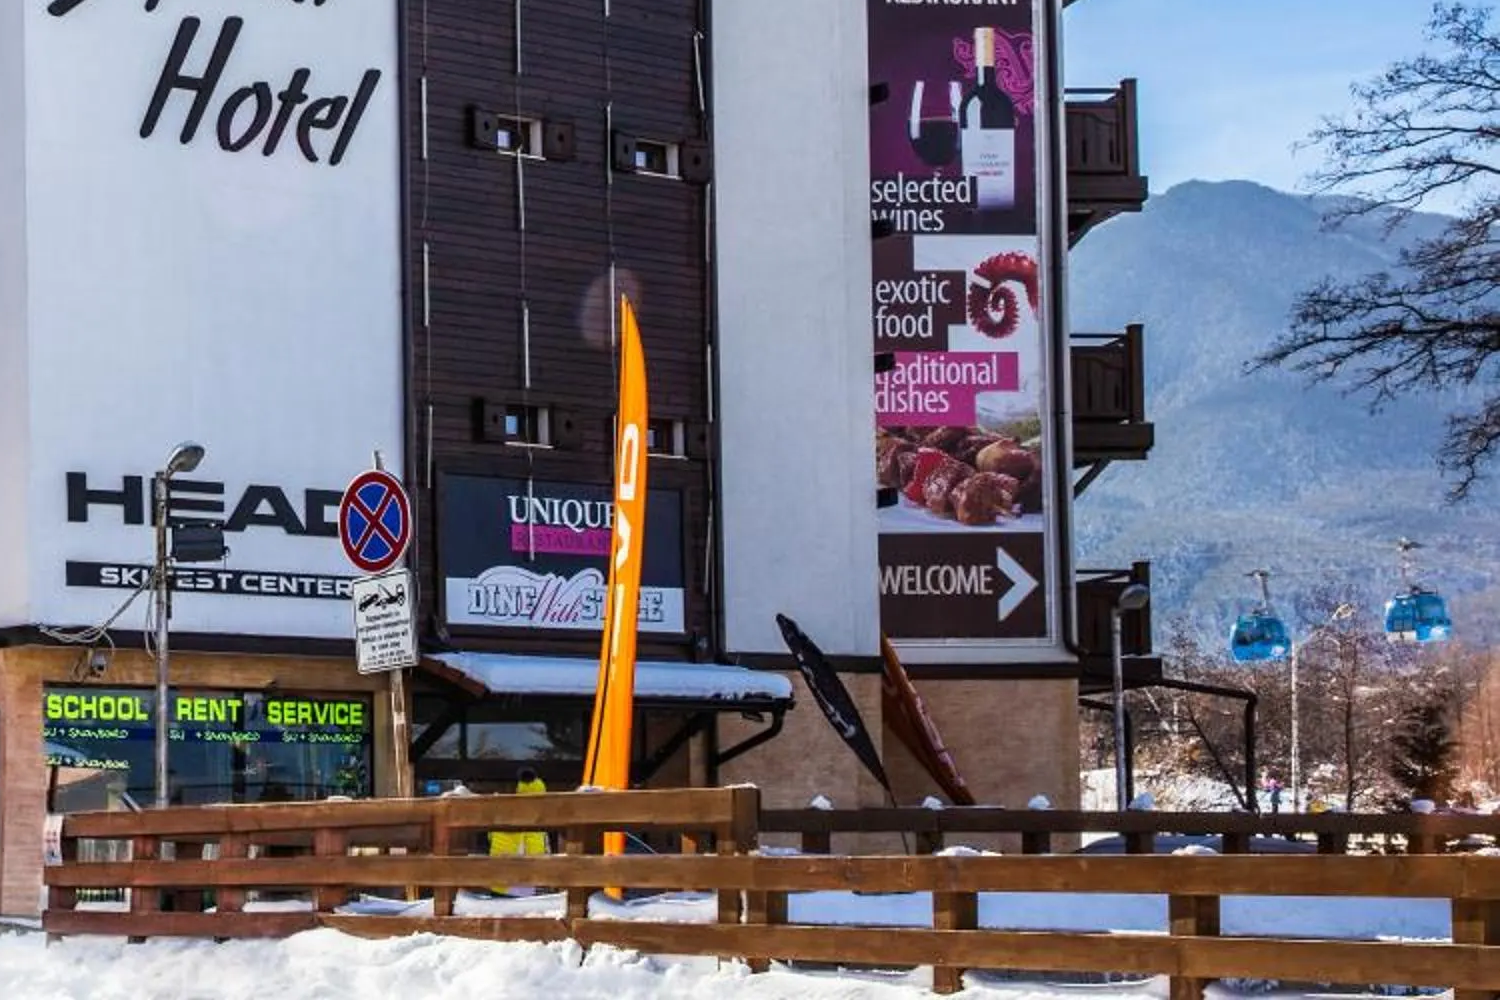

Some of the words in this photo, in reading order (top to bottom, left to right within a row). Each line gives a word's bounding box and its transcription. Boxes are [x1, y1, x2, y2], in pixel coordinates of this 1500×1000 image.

[140, 16, 381, 165] Hotel
[871, 172, 971, 203] selected
[875, 274, 950, 304] exotic
[875, 306, 933, 338] food
[875, 379, 949, 413] dishes
[100, 567, 151, 585] SKI
[166, 571, 233, 590] EST
[240, 574, 353, 598] CENTER
[879, 565, 993, 595] WELCOME
[468, 584, 536, 616] DINE
[47, 695, 148, 721] SCHOOL
[176, 697, 243, 722] RENT
[267, 700, 363, 725] SERVICE
